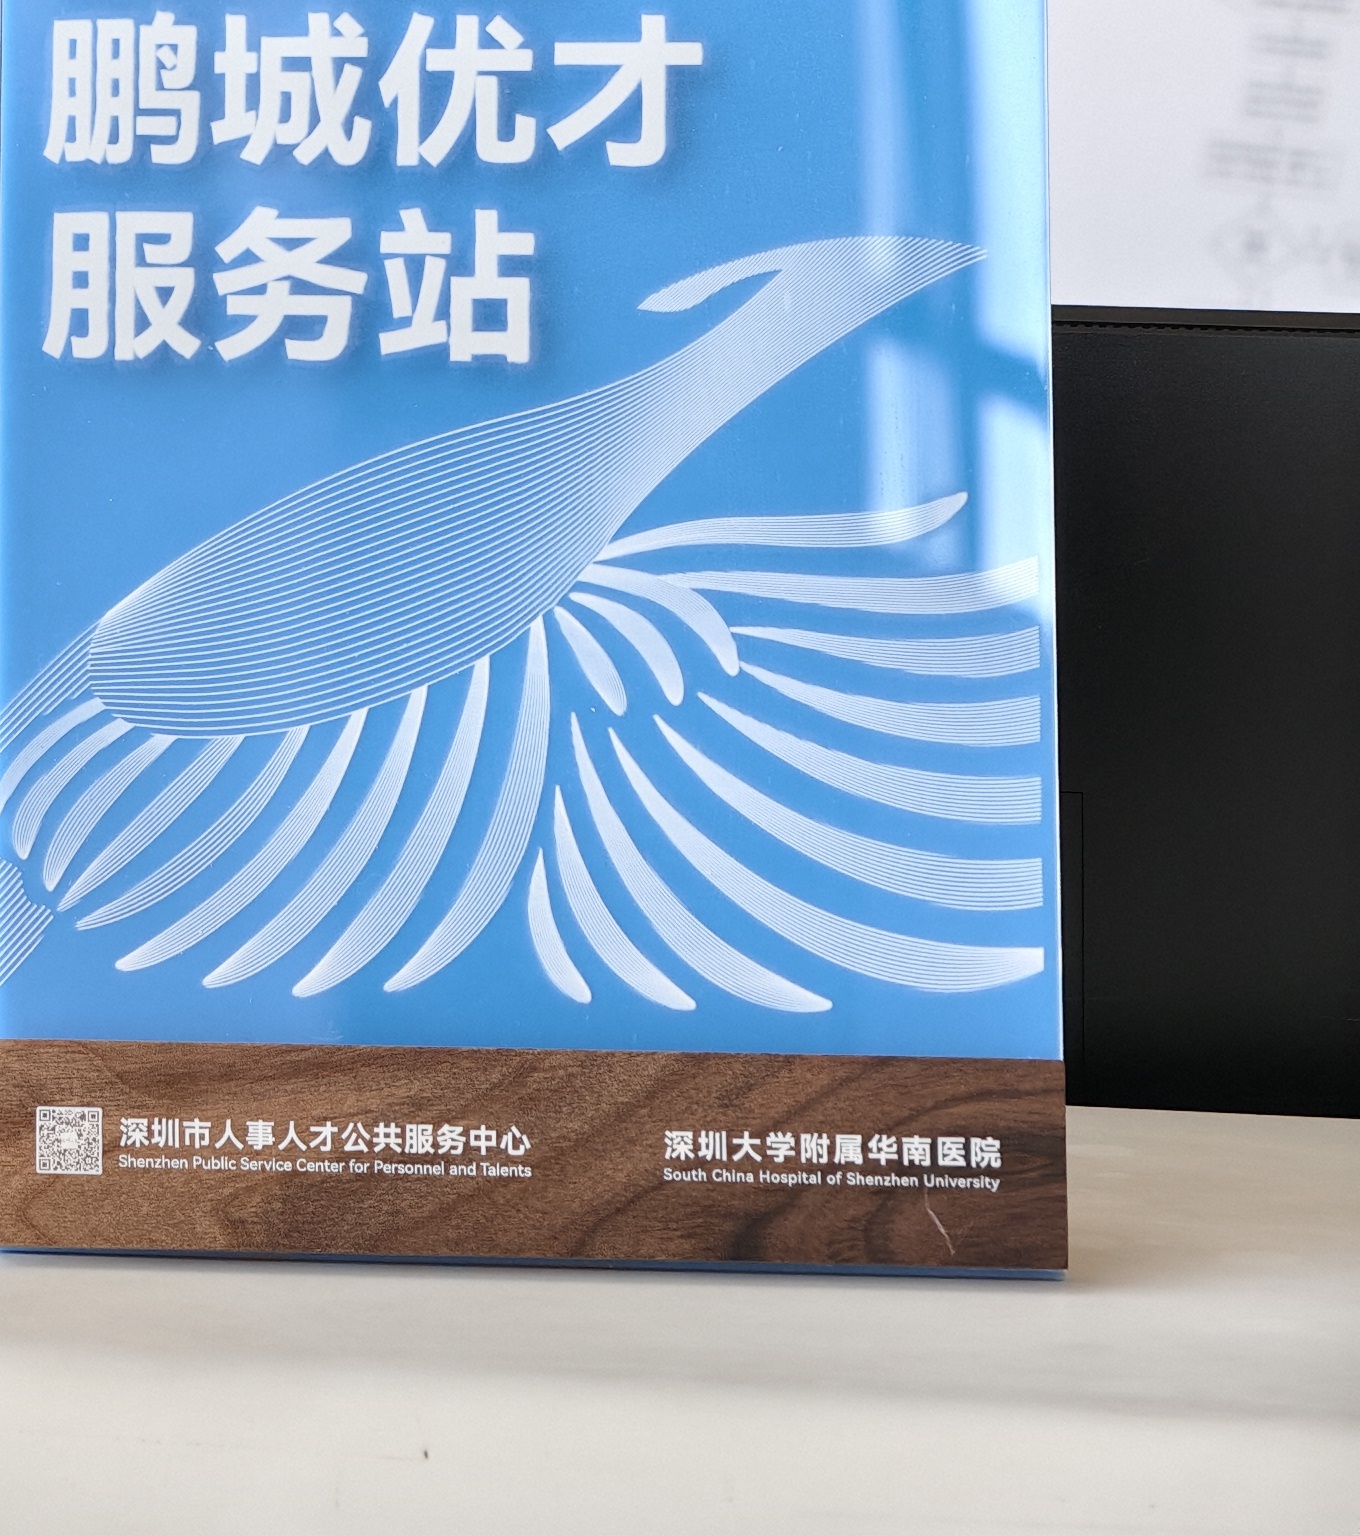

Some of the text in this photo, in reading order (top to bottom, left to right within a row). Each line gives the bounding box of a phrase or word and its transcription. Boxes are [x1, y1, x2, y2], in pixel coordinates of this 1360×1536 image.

[43, 10, 704, 168] 鹏城优才
[42, 205, 536, 364] 服务站
[119, 1117, 532, 1156] 深圳市人事人才公共服务中心
[663, 1130, 1002, 1170] 深圳大学附属华南医院
[118, 1153, 533, 1178] Shenzhen Public Service Center for Personnel and Talents
[663, 1167, 1001, 1192] South China Hospital of Shenzhen University
